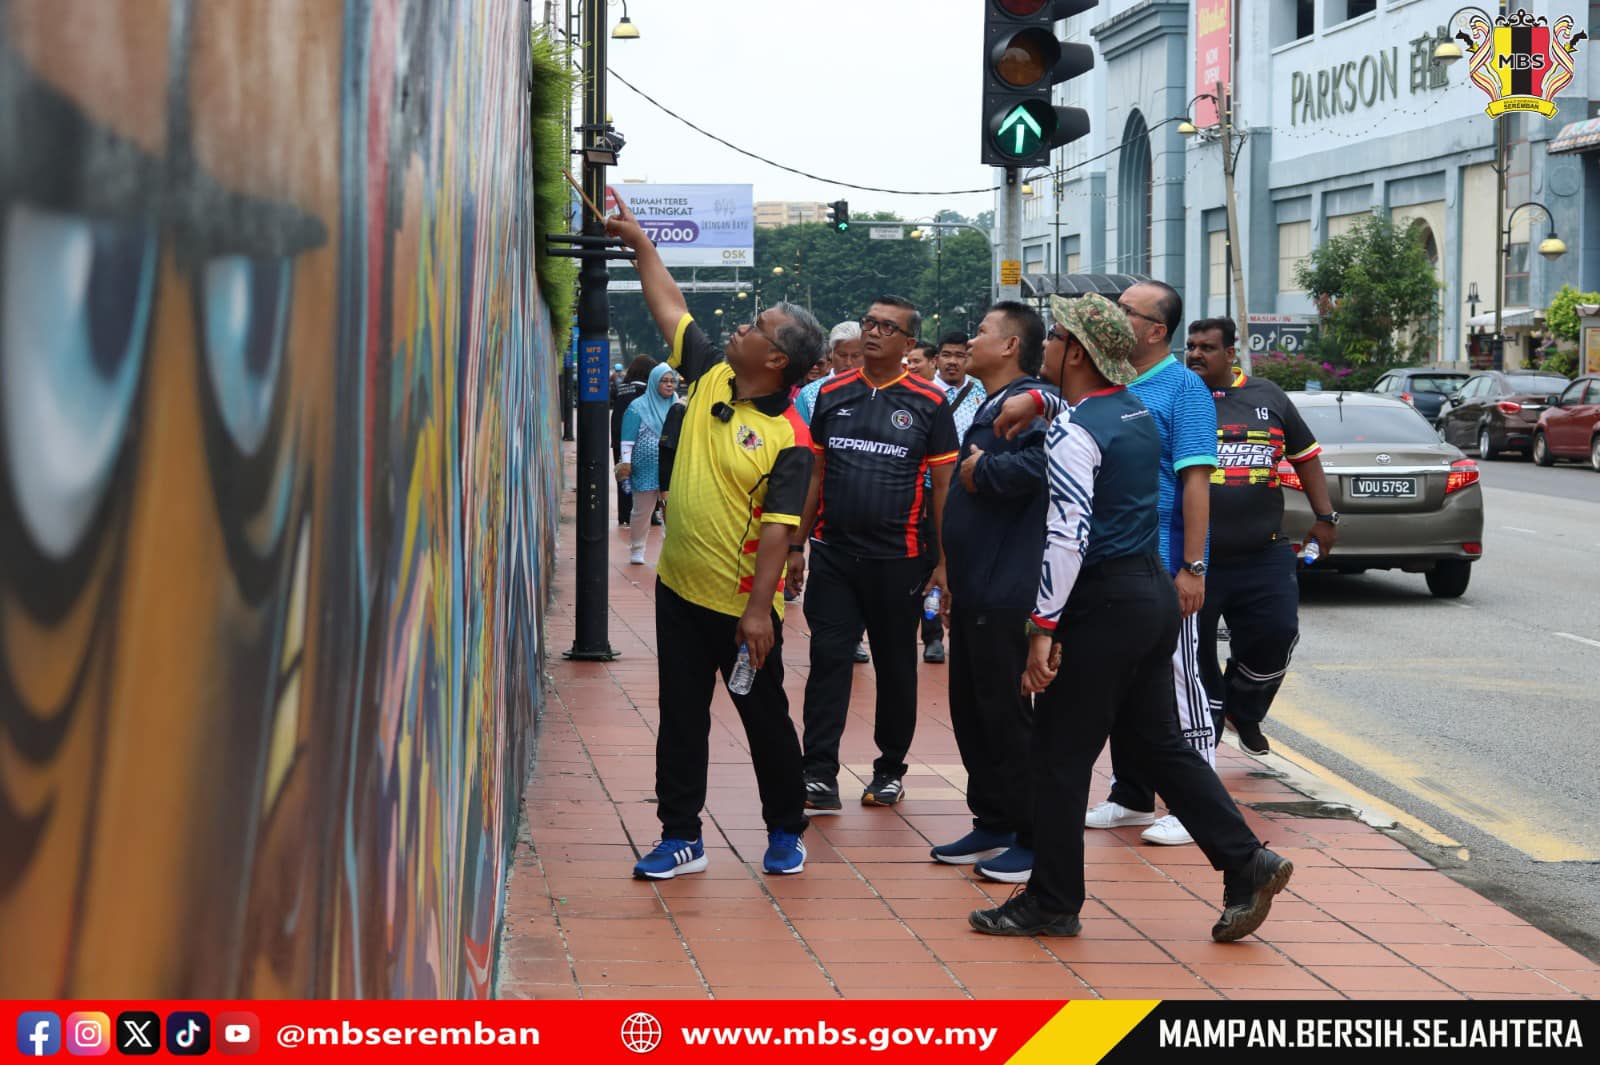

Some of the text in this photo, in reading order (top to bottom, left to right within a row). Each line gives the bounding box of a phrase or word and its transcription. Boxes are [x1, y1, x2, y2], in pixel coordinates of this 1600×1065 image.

[1291, 46, 1398, 128] PARKSON
[630, 197, 688, 206] RUMAH TERES
[649, 207, 694, 217] TINGKAT
[722, 250, 746, 260] OSK
[1255, 407, 1269, 420] 19
[1358, 481, 1410, 493] VDU 5752
